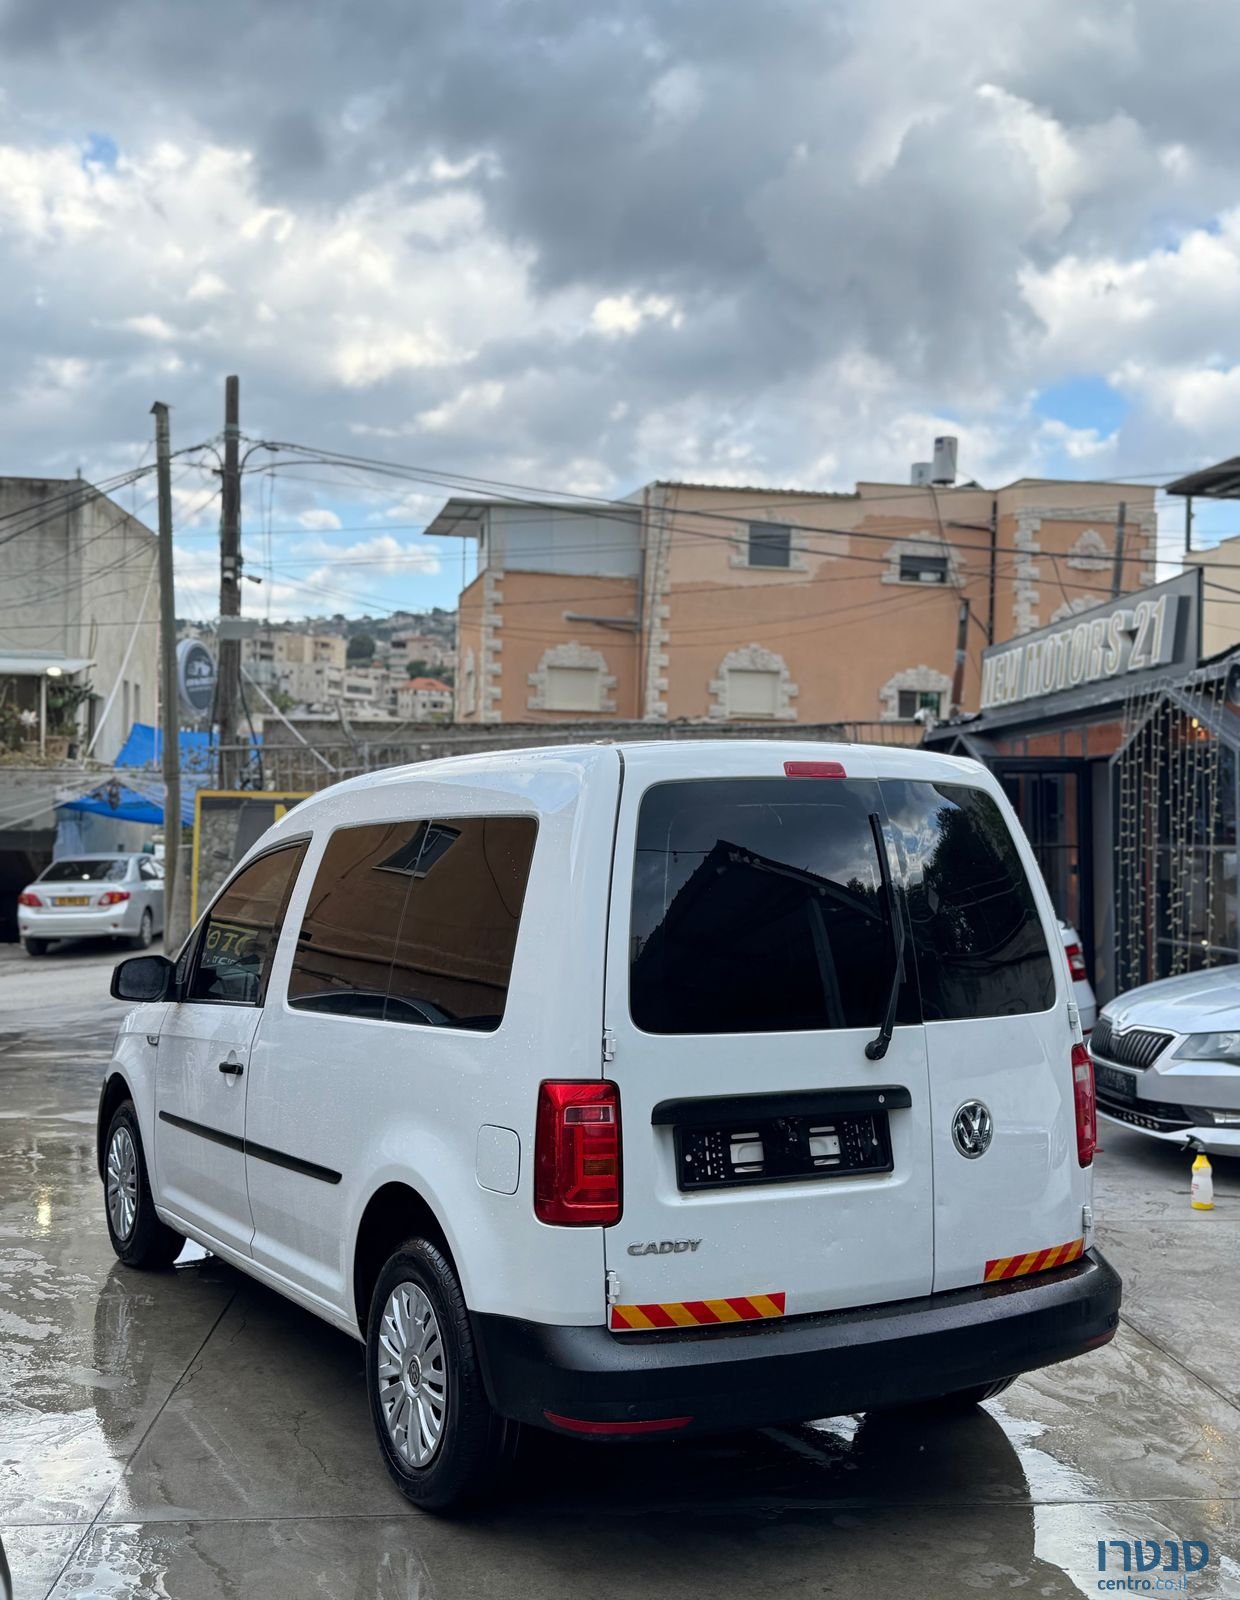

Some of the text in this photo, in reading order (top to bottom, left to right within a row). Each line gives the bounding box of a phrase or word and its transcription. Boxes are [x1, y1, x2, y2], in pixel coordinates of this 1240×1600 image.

[1023, 610, 1133, 699] MOTORS
[1128, 593, 1179, 671] 21
[626, 1239, 703, 1257] CADDY
